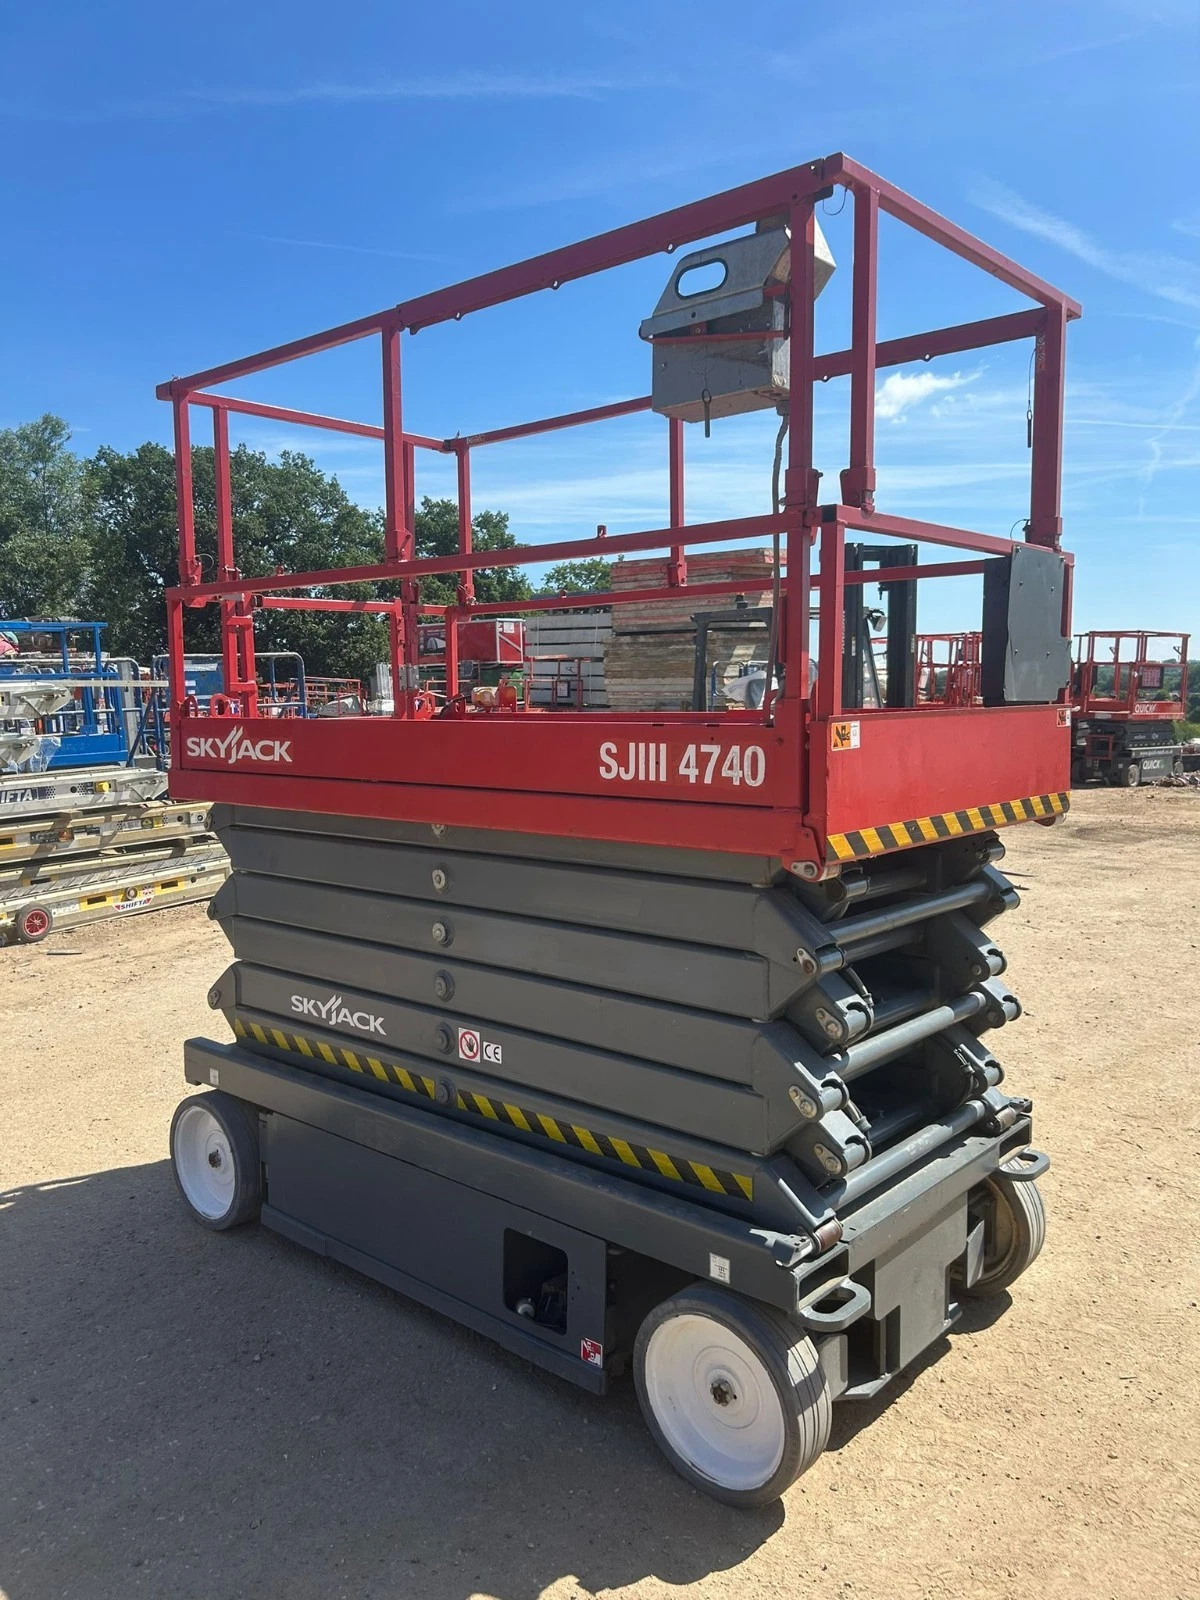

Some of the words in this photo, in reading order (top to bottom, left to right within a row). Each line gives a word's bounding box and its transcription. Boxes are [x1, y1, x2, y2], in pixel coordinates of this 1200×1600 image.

[186, 725, 293, 764] SKYJACK
[599, 741, 667, 782] SJIII
[678, 743, 766, 787] 4740
[120, 899, 148, 910] SHIFTA
[291, 994, 387, 1036] SKYJACK
[484, 1043, 501, 1062] CE
